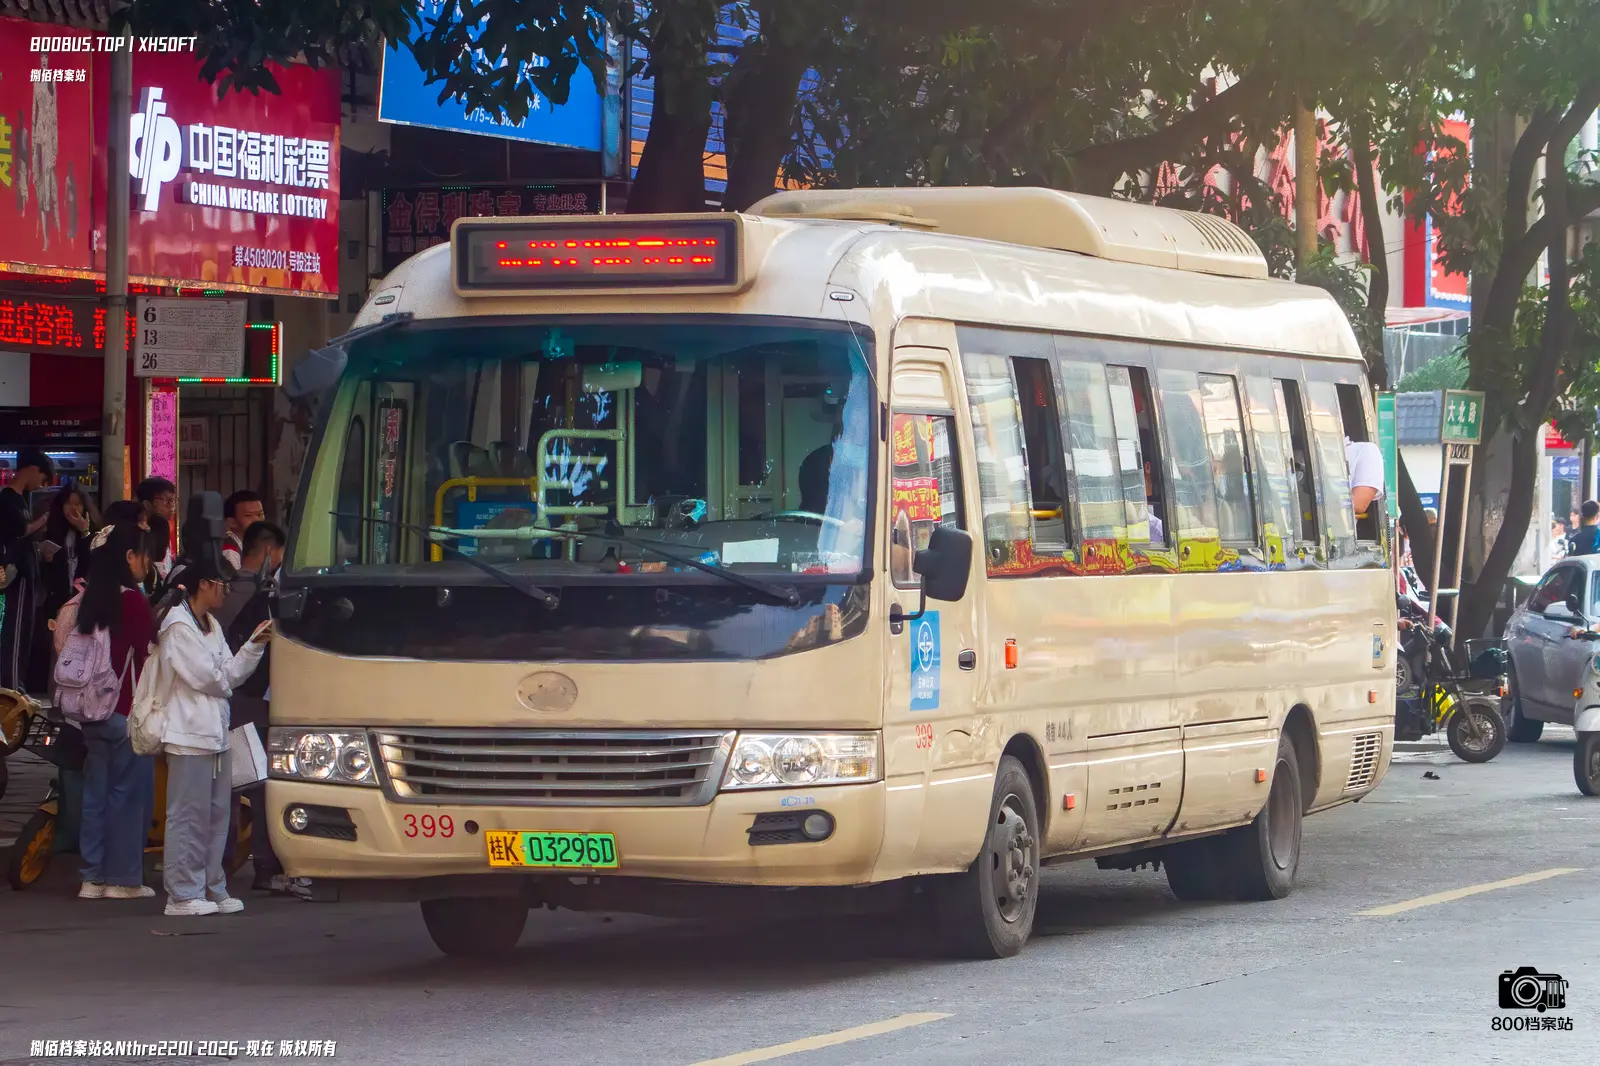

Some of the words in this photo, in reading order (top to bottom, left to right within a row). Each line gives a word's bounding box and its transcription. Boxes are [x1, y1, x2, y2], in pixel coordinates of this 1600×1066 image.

[189, 123, 329, 189] 中国福利彩票
[190, 182, 227, 208] CHINA
[229, 187, 279, 214] WELFARE
[282, 194, 328, 219] LOTTERY
[144, 306, 156, 323] 6
[143, 329, 157, 345] 13
[142, 352, 157, 369] 26
[915, 723, 933, 749] 399
[403, 814, 455, 838] 399
